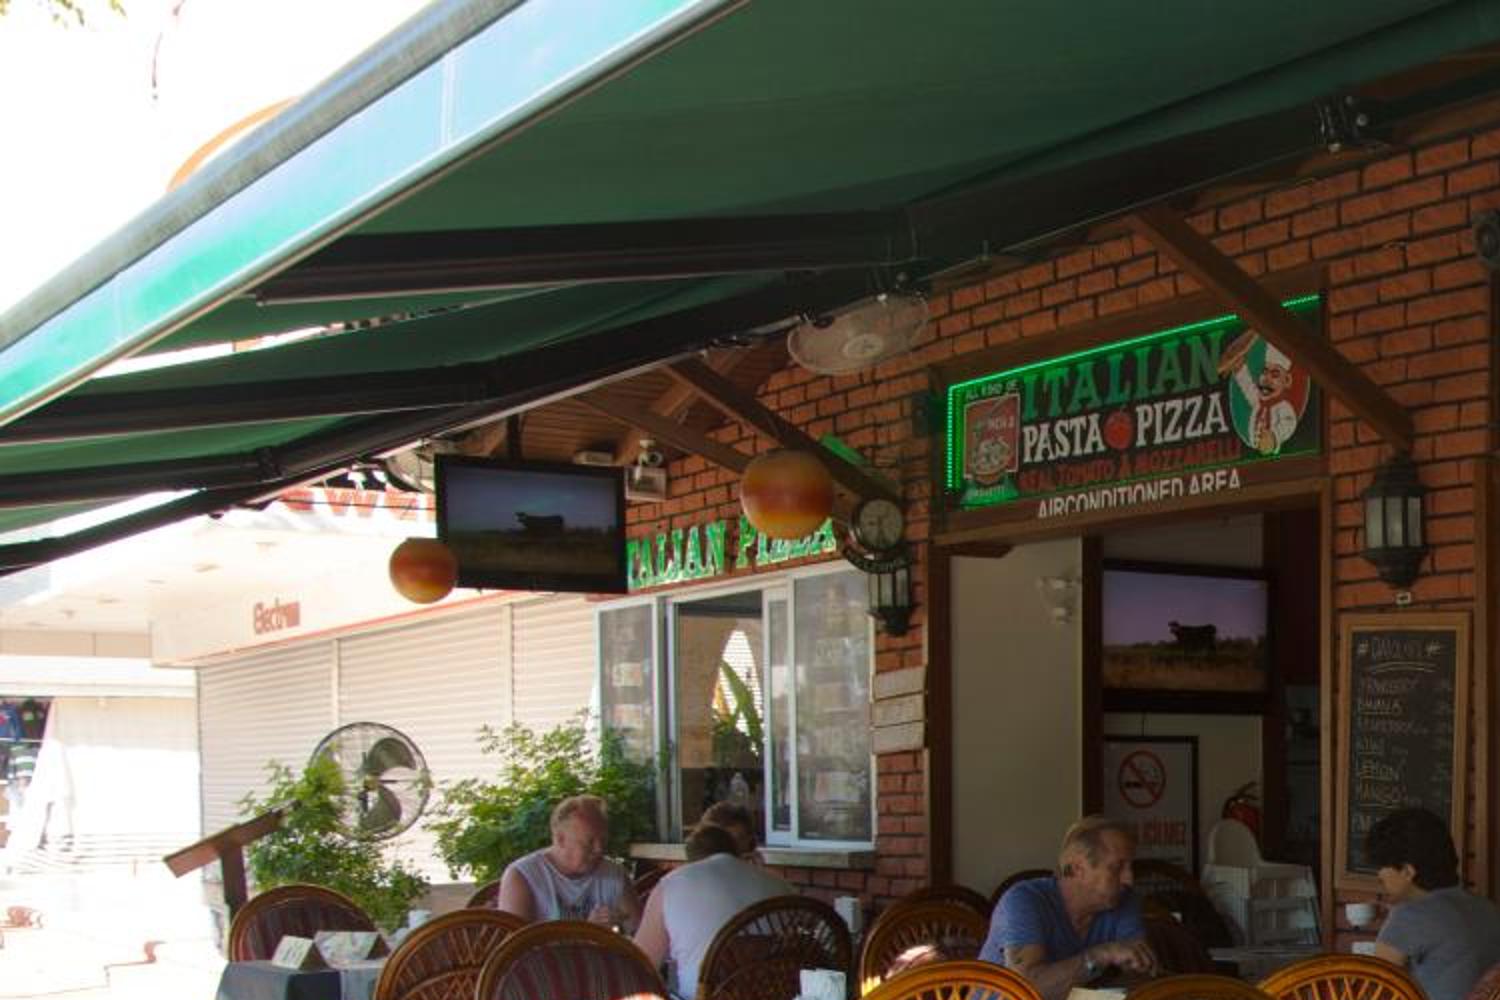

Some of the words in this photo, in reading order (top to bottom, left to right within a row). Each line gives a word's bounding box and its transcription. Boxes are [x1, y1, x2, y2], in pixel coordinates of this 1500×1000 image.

[1023, 329, 1227, 422] ITALIAN
[1022, 412, 1108, 464] PASTA
[1135, 391, 1230, 448] PIZZA
[627, 519, 726, 588] TALIAN
